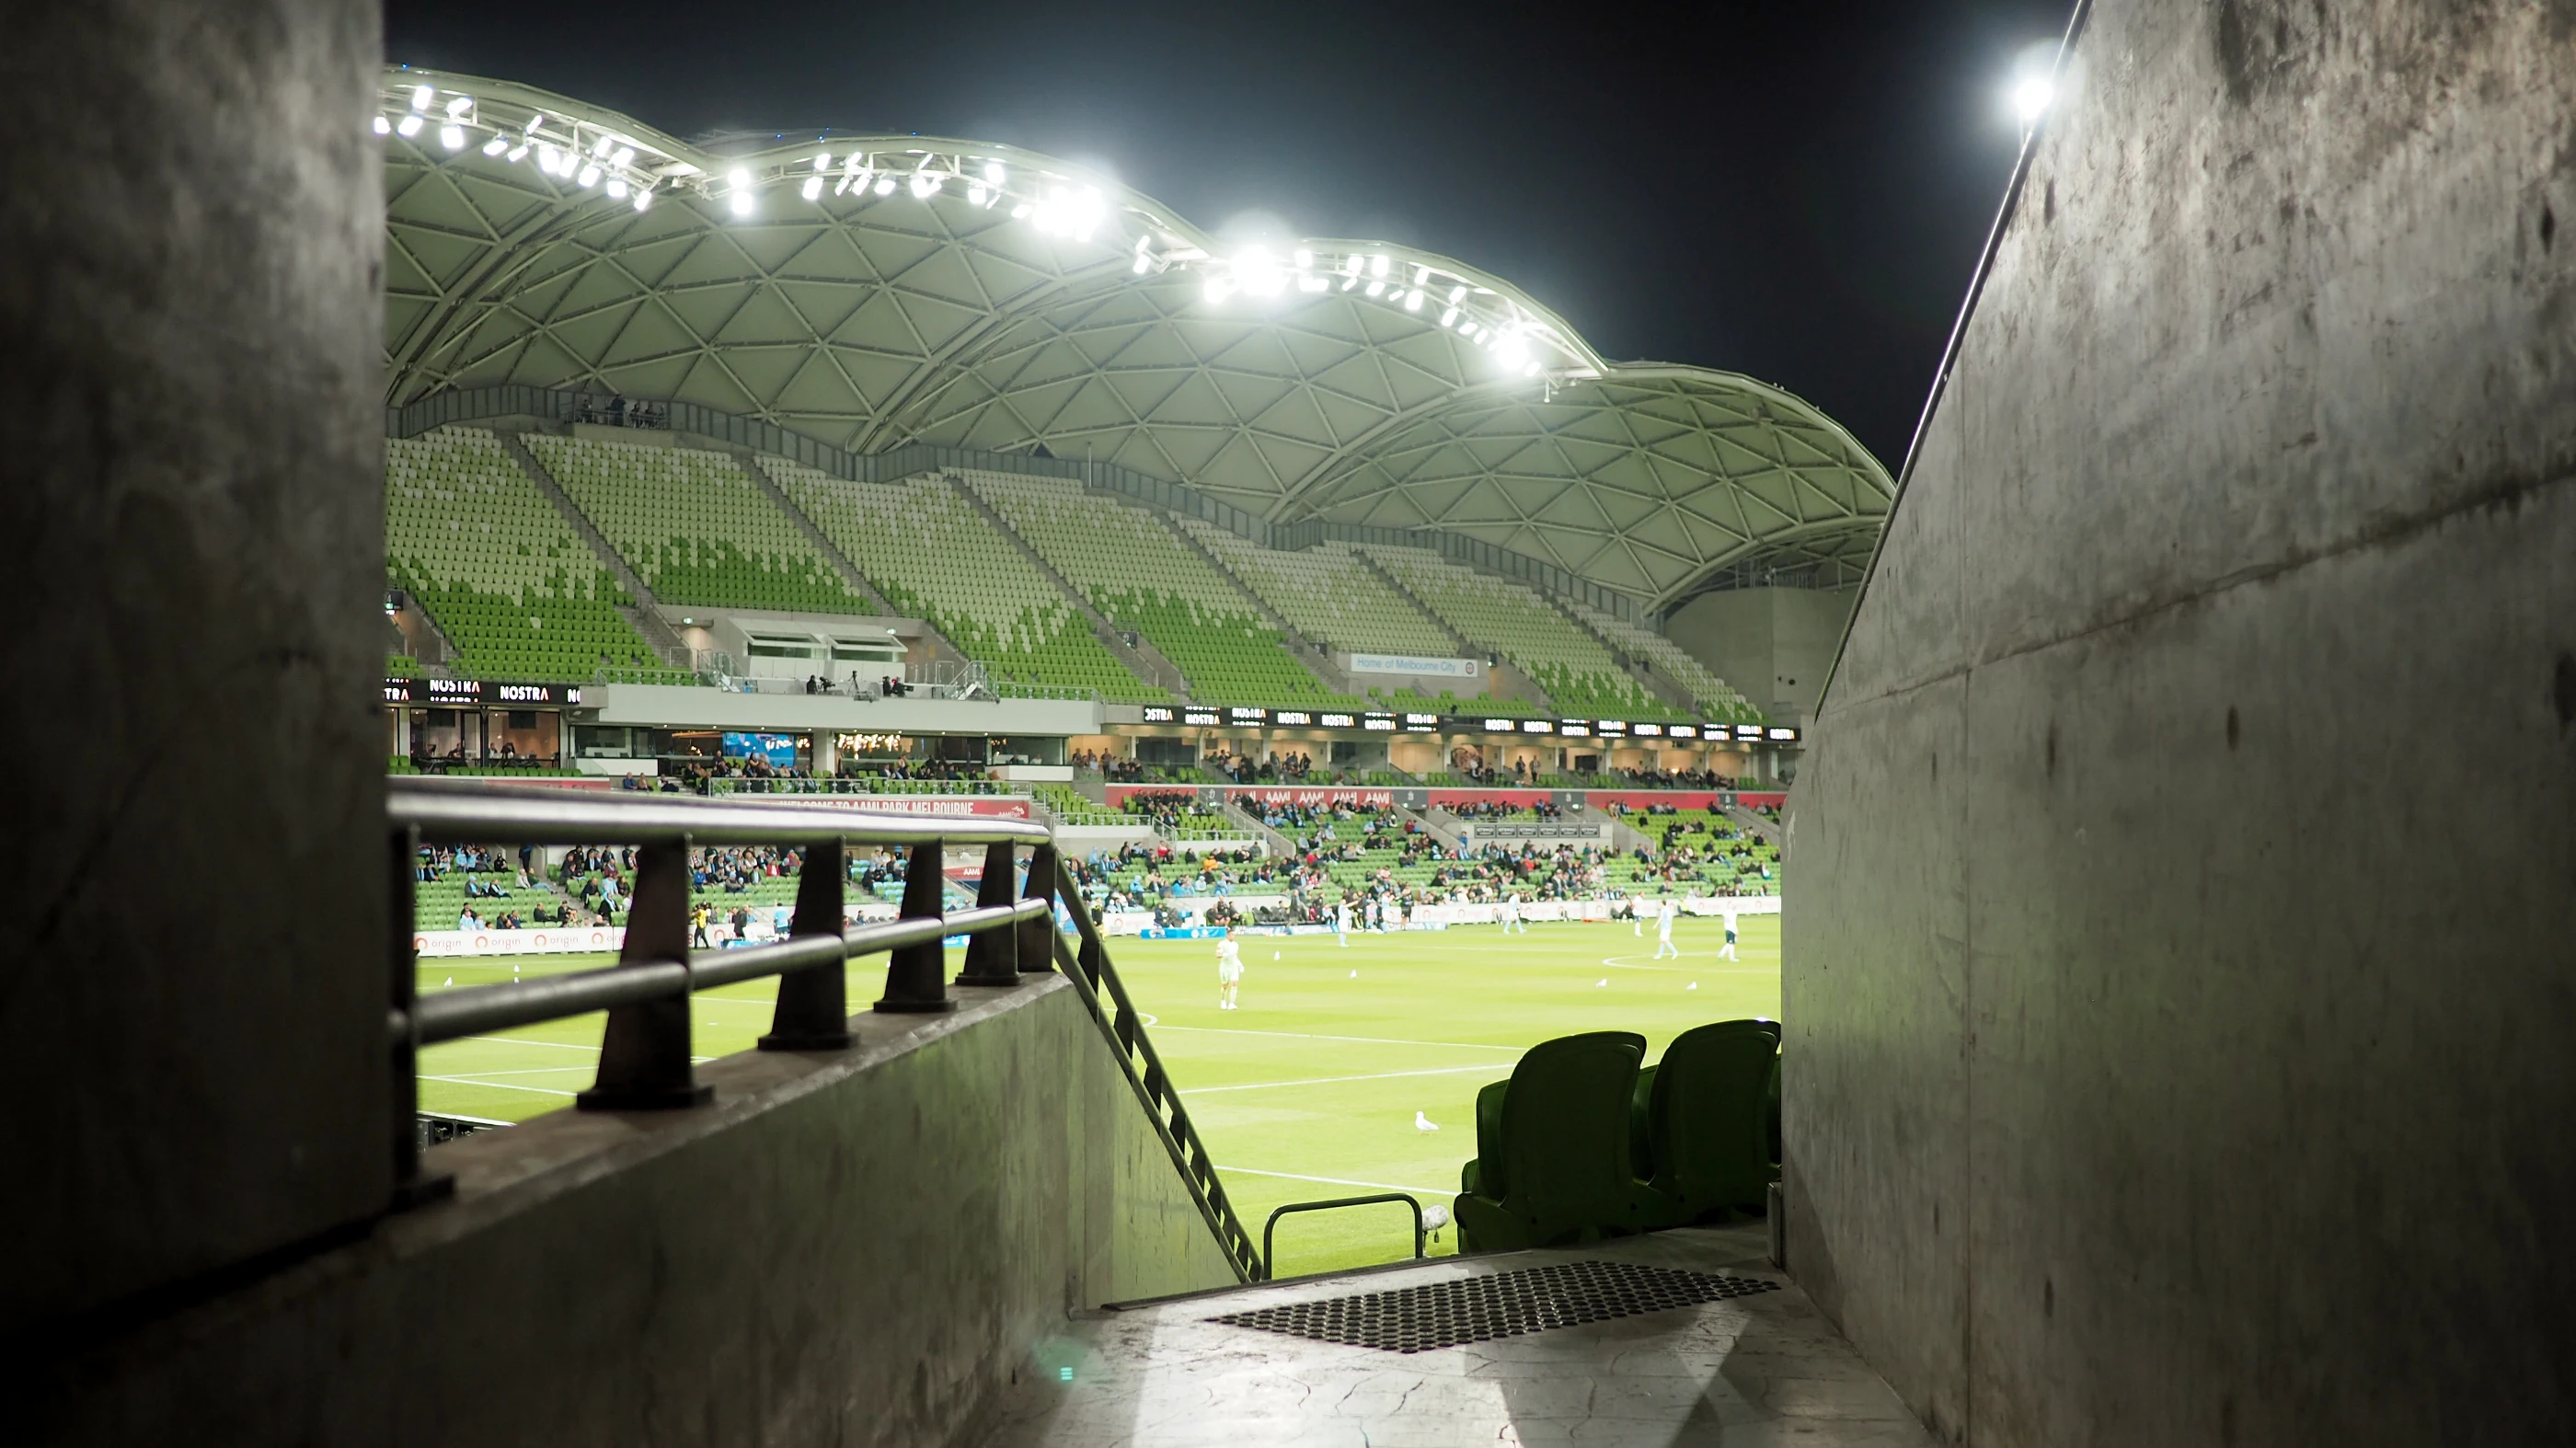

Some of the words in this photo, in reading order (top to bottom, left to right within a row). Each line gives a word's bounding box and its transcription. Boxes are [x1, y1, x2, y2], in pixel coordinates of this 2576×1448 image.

[1357, 657, 1381, 668] Home
[1386, 659, 1394, 668] of
[1396, 660, 1439, 672] Melbourne
[1441, 661, 1456, 673] City
[384, 687, 409, 701] TRA
[500, 685, 549, 701] NOSTRA
[1144, 707, 1173, 721] OSTRA
[1185, 713, 1220, 725] NOSTRA
[1277, 712, 1311, 725] NOSTRA
[1321, 714, 1355, 727] NOSTRA
[1364, 719, 1397, 730] NOSTRA
[1485, 718, 1515, 731] NOSTRA
[1524, 720, 1554, 733] NOSTRA
[1266, 790, 1291, 803] AAMI
[1299, 791, 1324, 804] AAMI
[1365, 792, 1389, 805] AAMI
[836, 801, 850, 810] TO
[854, 801, 880, 811] AAMI
[883, 802, 909, 812] PARK
[913, 802, 973, 814] MELBOURNE
[963, 868, 981, 876] AAMI
[431, 939, 462, 951] origin
[491, 937, 521, 949] origin
[550, 936, 579, 948] origin
[606, 934, 626, 947] orig
